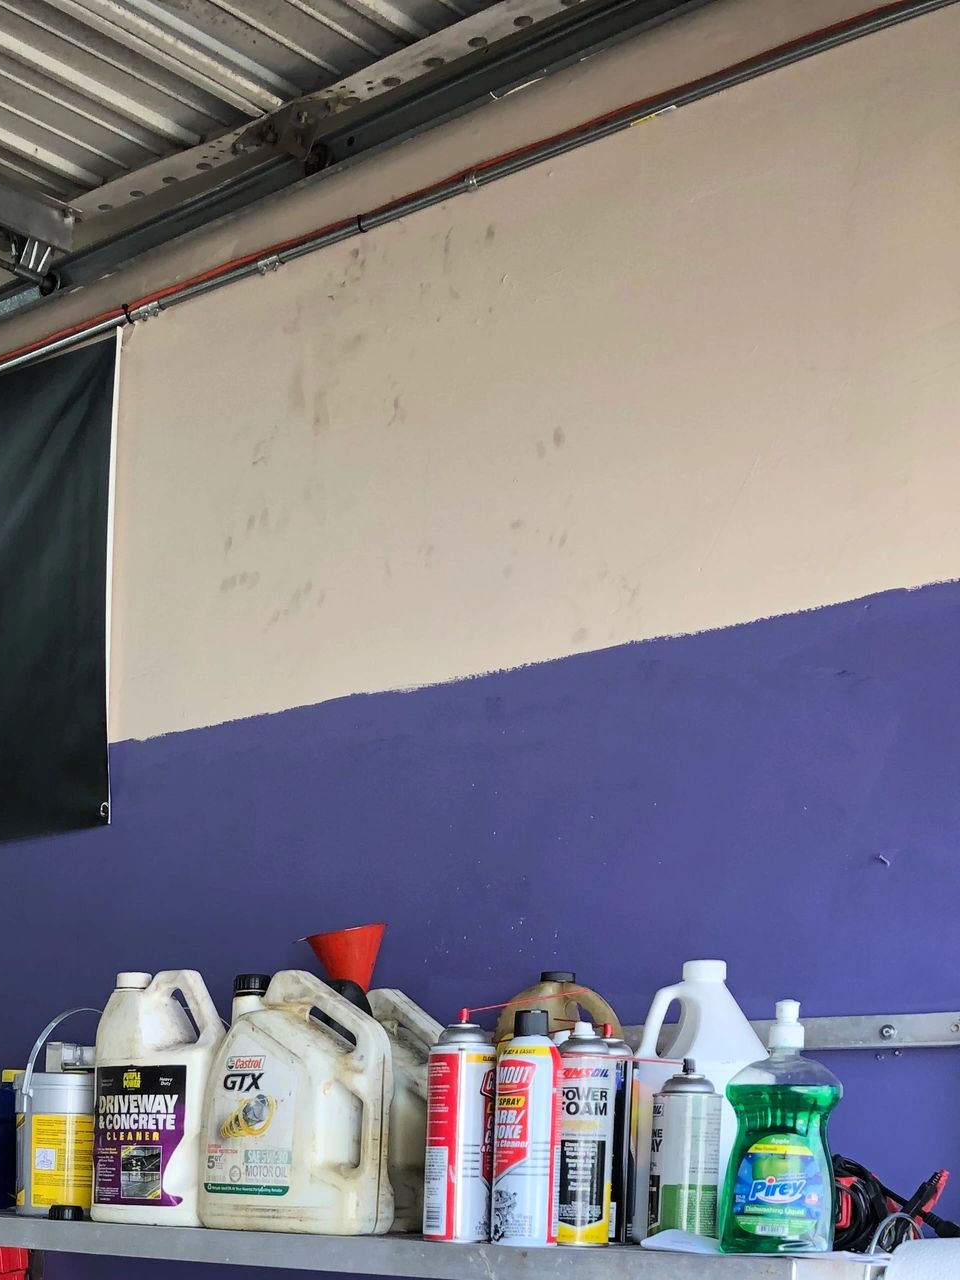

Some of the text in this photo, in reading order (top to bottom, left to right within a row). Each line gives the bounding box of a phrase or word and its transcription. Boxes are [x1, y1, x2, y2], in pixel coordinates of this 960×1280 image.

[235, 1058, 262, 1069] Castrol
[497, 1065, 533, 1084] MOUT
[223, 1072, 265, 1093] GTX
[563, 1087, 608, 1101] OWER
[98, 1094, 179, 1113] DRIVEWAY
[499, 1098, 521, 1106] SPRAY
[562, 1101, 607, 1116] OAM
[106, 1114, 176, 1130] CONCRETE
[106, 1131, 160, 1141] CLEANER
[652, 1129, 663, 1138] NE
[651, 1139, 662, 1152] AY
[207, 1155, 215, 1169] 5
[245, 1165, 287, 1178] MOTOR OIL
[750, 1176, 806, 1200] Pirey
